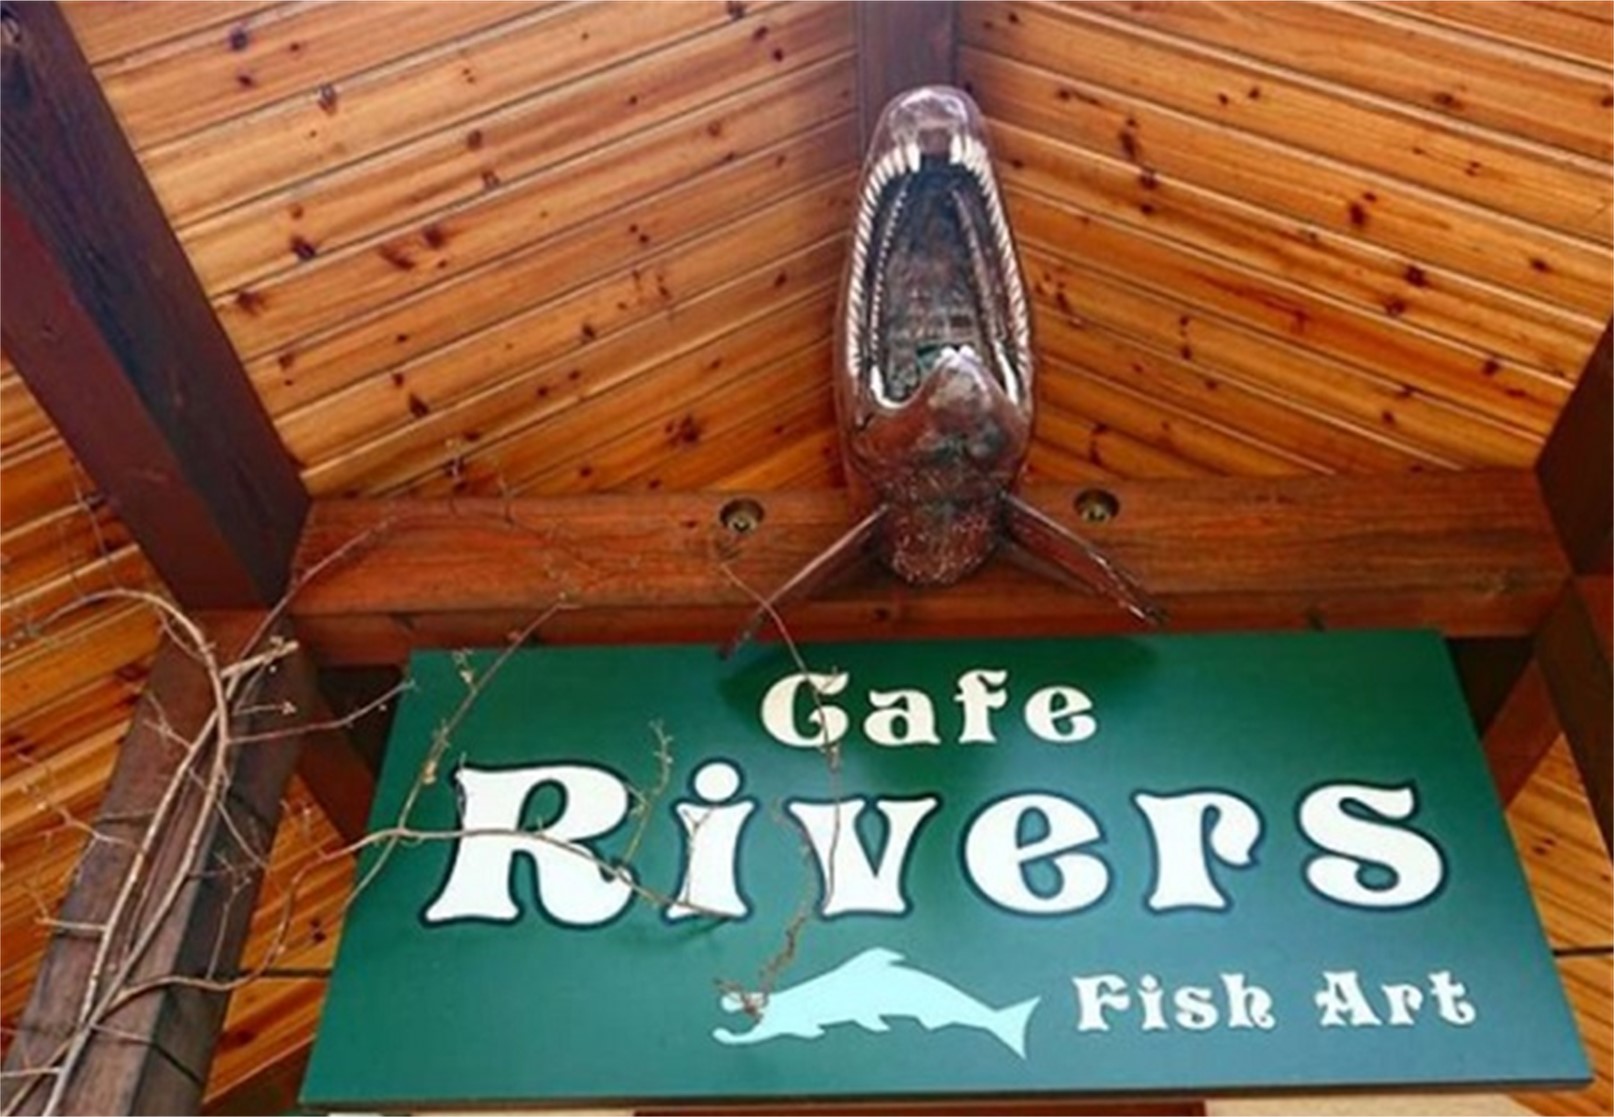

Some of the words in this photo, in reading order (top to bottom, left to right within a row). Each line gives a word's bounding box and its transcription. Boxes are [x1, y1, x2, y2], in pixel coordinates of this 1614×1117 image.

[760, 669, 1098, 748] Cafe
[424, 761, 1446, 926] Rivers
[1073, 972, 1277, 1033] Fish
[1316, 969, 1477, 1028] Art
